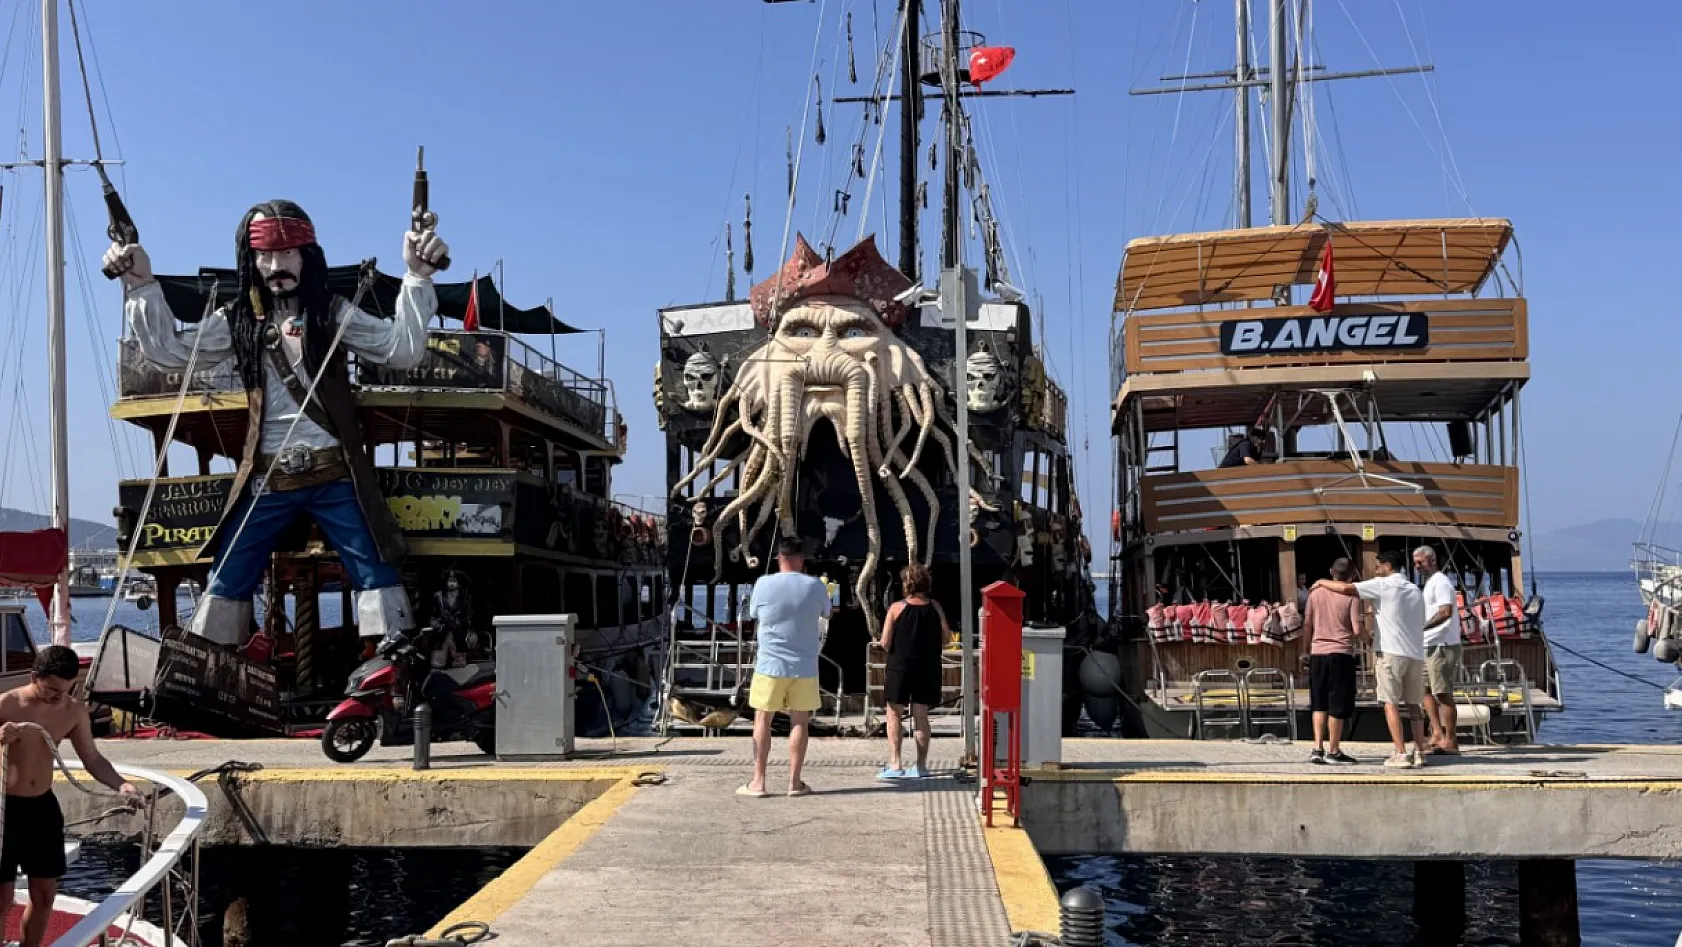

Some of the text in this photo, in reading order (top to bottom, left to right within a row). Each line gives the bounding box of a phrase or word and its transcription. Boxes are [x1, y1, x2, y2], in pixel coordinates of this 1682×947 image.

[1229, 315, 1419, 351] B.ANGEL
[162, 479, 222, 500] JACK
[143, 523, 218, 546] PIRAT
